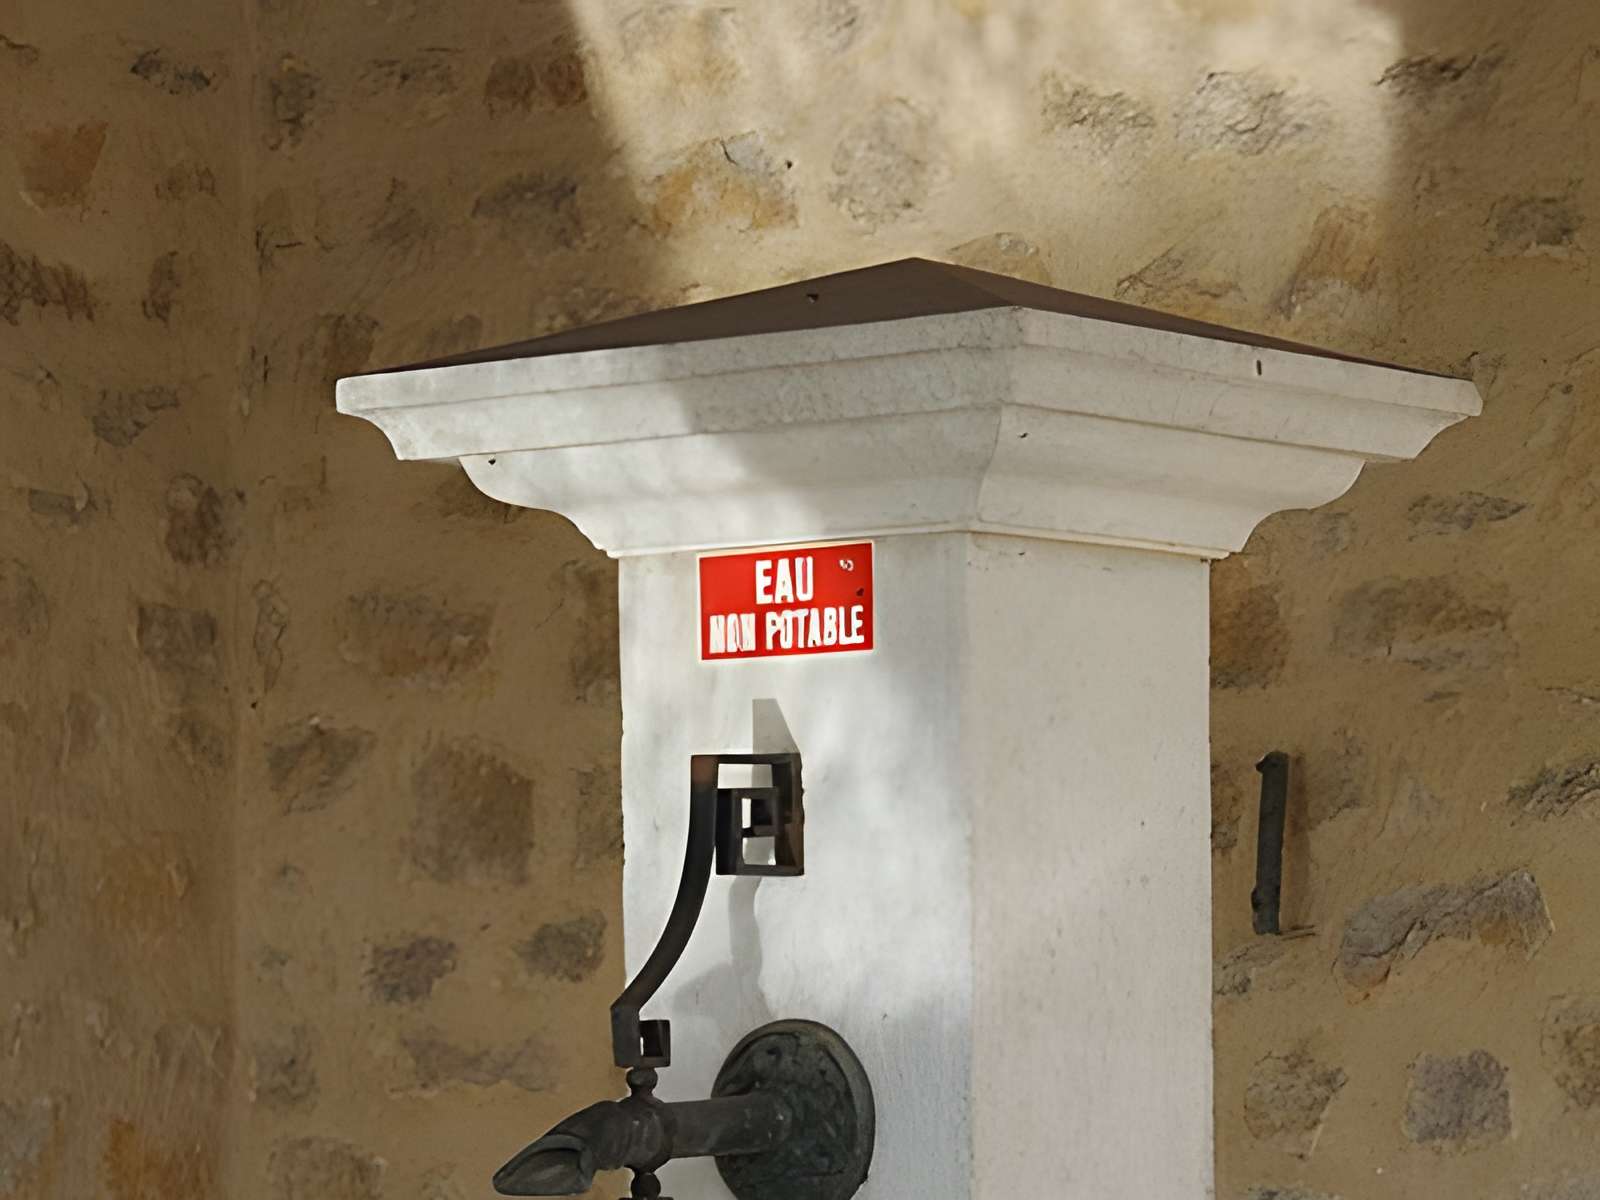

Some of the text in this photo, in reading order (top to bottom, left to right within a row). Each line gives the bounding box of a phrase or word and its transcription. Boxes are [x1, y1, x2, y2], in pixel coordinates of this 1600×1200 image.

[755, 556, 814, 605] EAU
[709, 604, 865, 654] NON POTABLE
